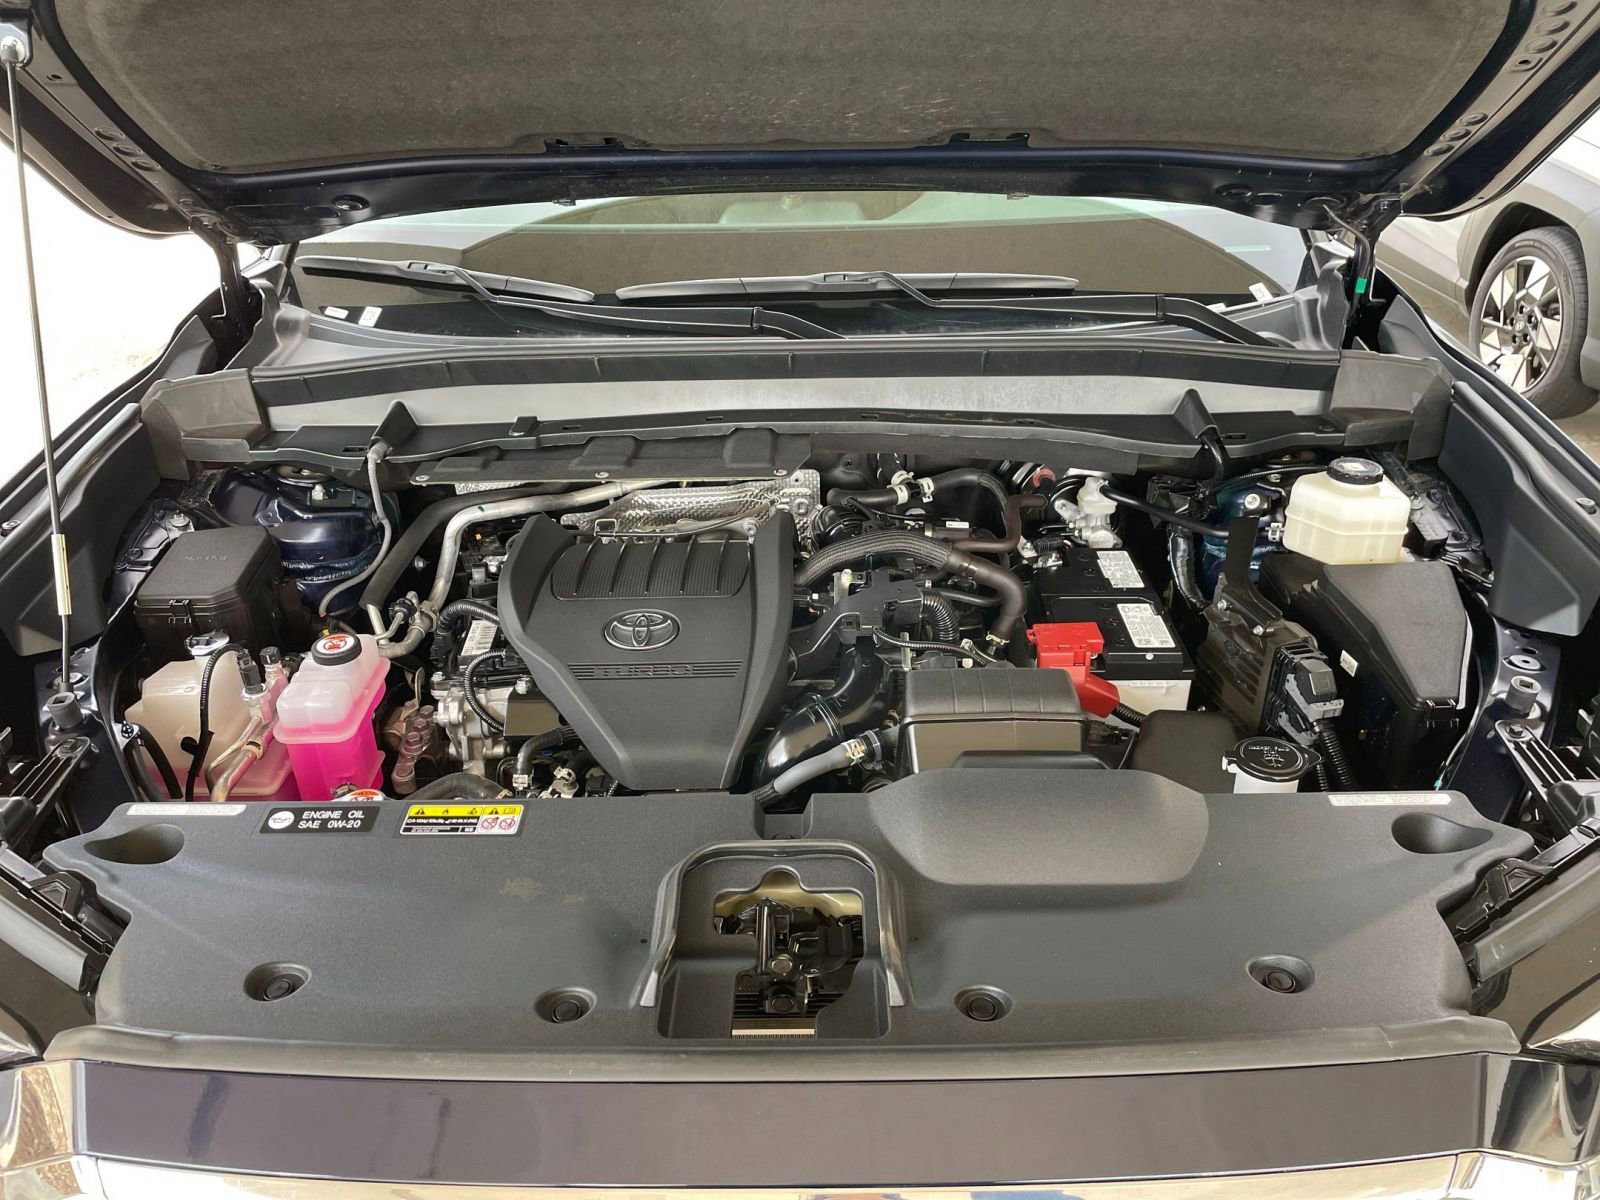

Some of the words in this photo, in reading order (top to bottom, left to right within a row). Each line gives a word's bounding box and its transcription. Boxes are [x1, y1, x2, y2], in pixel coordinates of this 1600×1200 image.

[596, 664, 691, 677] TURBO
[302, 811, 342, 819] ENGINE
[348, 810, 364, 818] OIL
[298, 821, 321, 829] SAE
[327, 820, 361, 828] 0W-20
